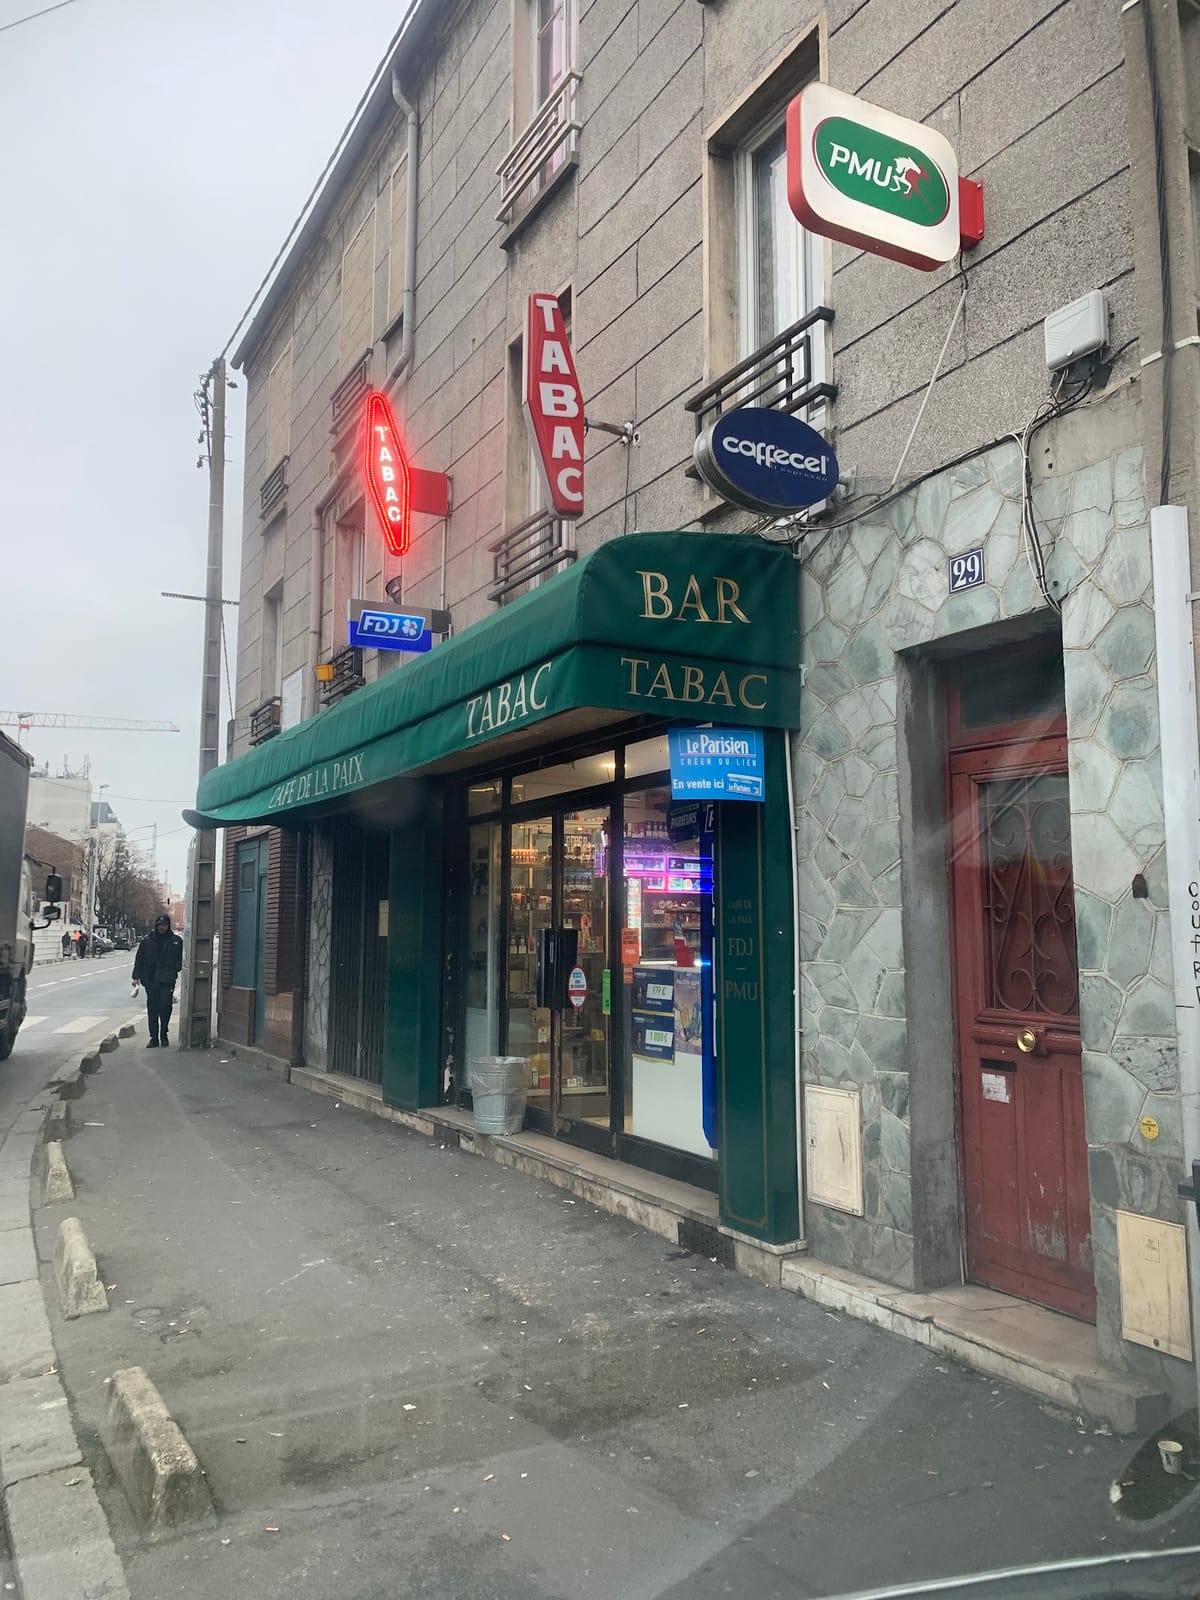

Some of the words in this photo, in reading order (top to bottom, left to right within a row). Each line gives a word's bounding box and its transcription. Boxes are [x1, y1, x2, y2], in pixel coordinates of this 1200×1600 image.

[829, 142, 893, 187] PMU
[535, 298, 583, 502] TABAC
[374, 426, 401, 522] TABAC
[722, 436, 827, 475] caffecel
[953, 554, 980, 588] 29
[635, 570, 751, 624] BAR
[363, 615, 400, 634] FDJ
[465, 661, 552, 739] TABAC
[620, 656, 767, 710] TABAC
[686, 738, 699, 754] Le
[699, 734, 749, 754] Parisien
[718, 758, 730, 766] DU
[736, 758, 757, 767] LIEN
[296, 773, 313, 801] DE
[313, 767, 329, 796] LA
[332, 752, 365, 790] PAIX
[672, 778, 684, 789] En
[686, 779, 712, 789] vente
[713, 778, 725, 789] ici
[727, 938, 754, 956] FDJ
[724, 981, 759, 1001] PMU
